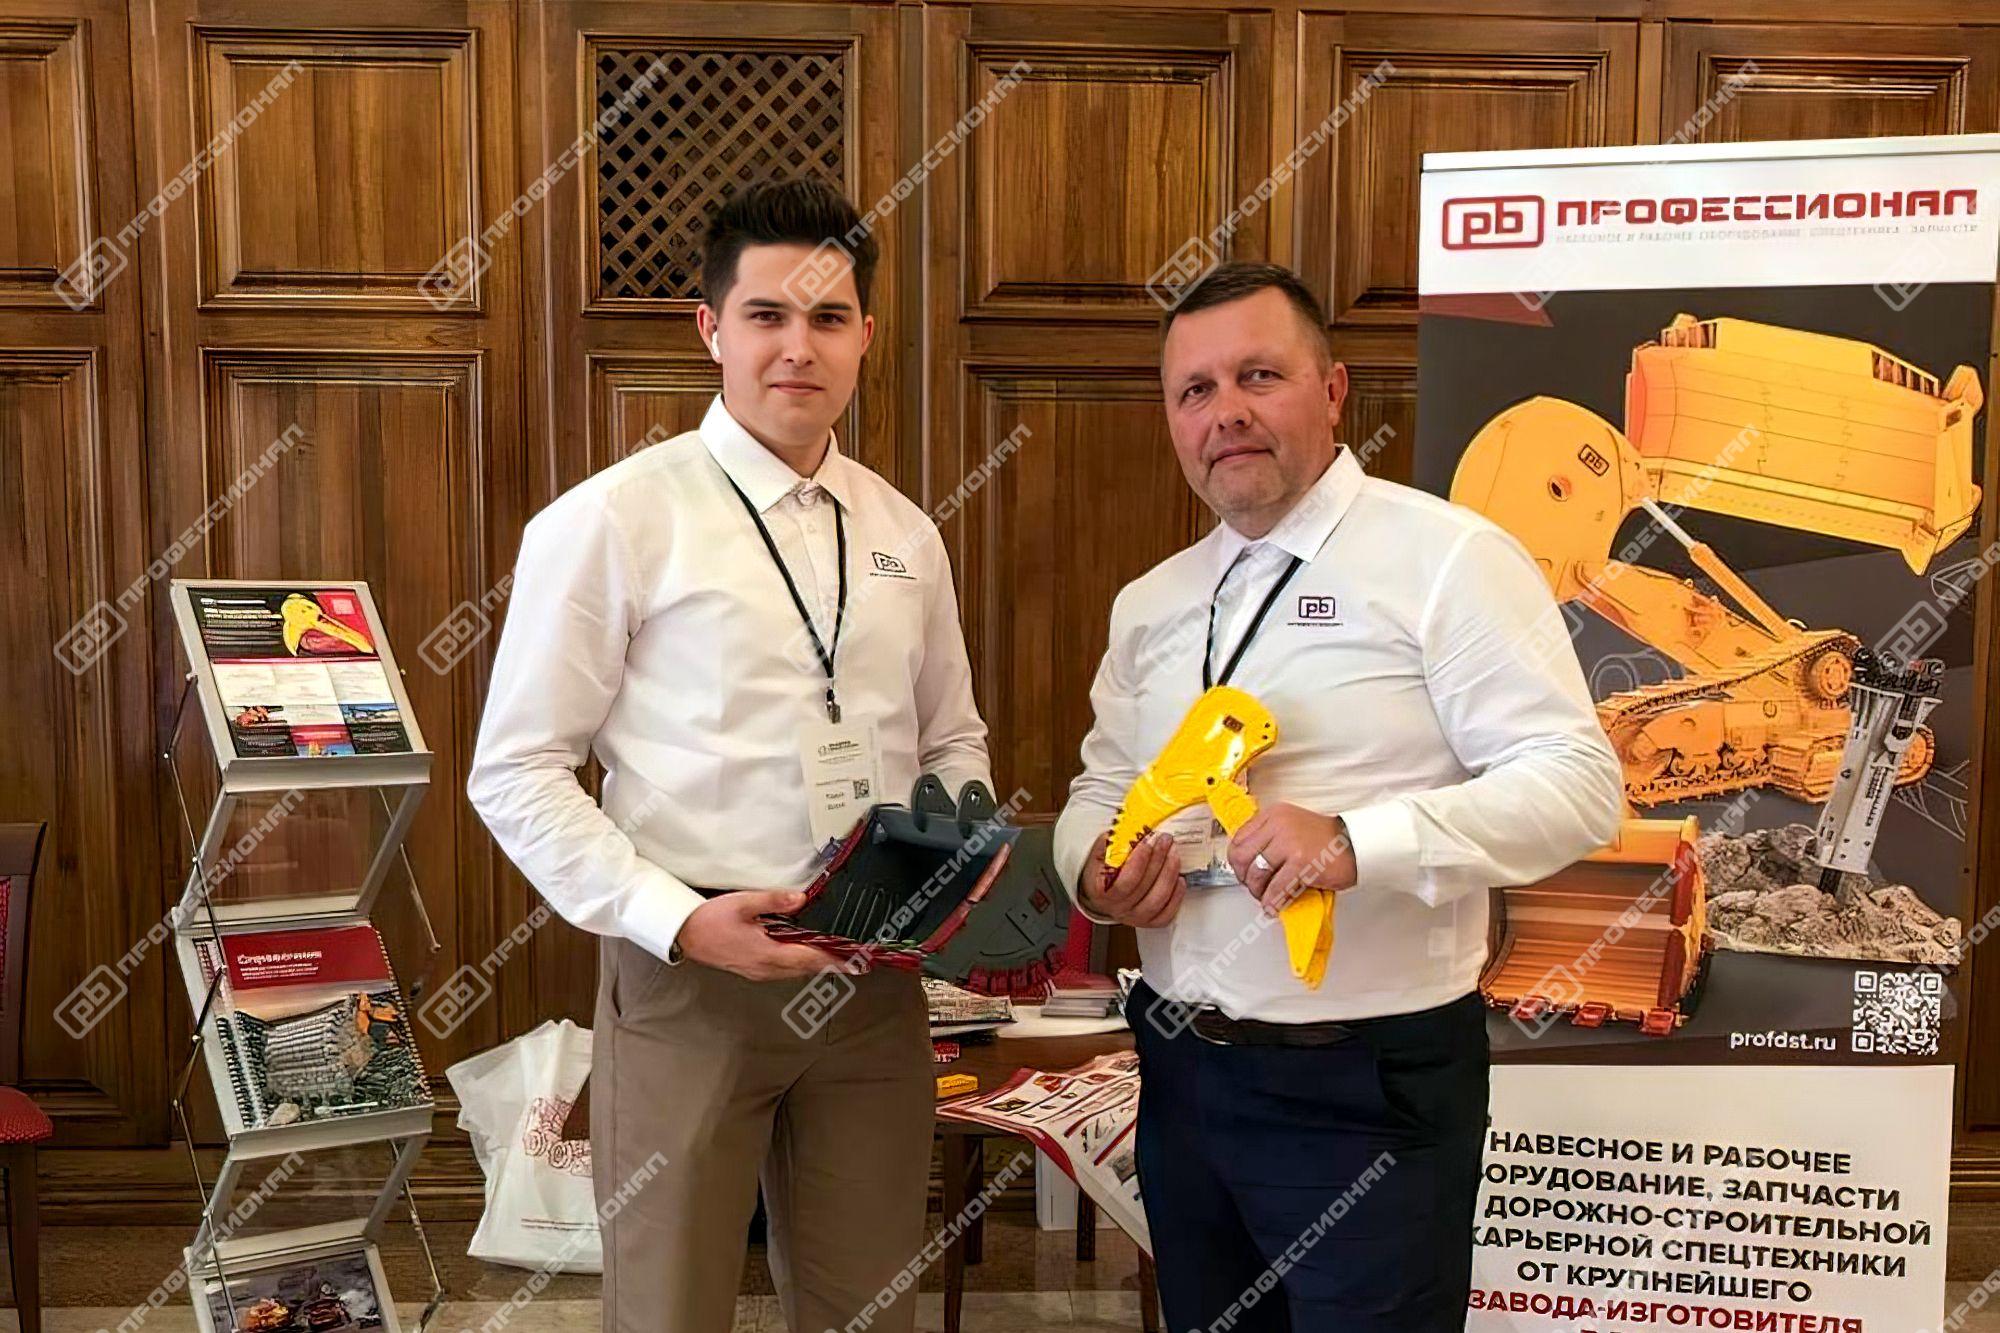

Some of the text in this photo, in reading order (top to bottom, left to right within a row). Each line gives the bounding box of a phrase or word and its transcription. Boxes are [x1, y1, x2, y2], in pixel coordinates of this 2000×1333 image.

[1730, 1030, 1836, 1051] profdst.ru
[1489, 1131, 1851, 1174] НАВЕСНОЕ И РАБОЧЕЕ
[1481, 1163, 1900, 1212] ОРУДОВАНИЕ, ЗАПЧАСТИ
[1484, 1195, 1931, 1246] ДОРОЖНО-СТРОИТЕЛЬНОЙ
[1661, 1239, 1906, 1277] СПЕЦТЕХНИКИ
[1517, 1260, 1812, 1302] ОТ КРУПНЕЙШЕГО
[1468, 1289, 1863, 1333] ЗАВОДА-ИЗГОТОВИТЕЛЯ
